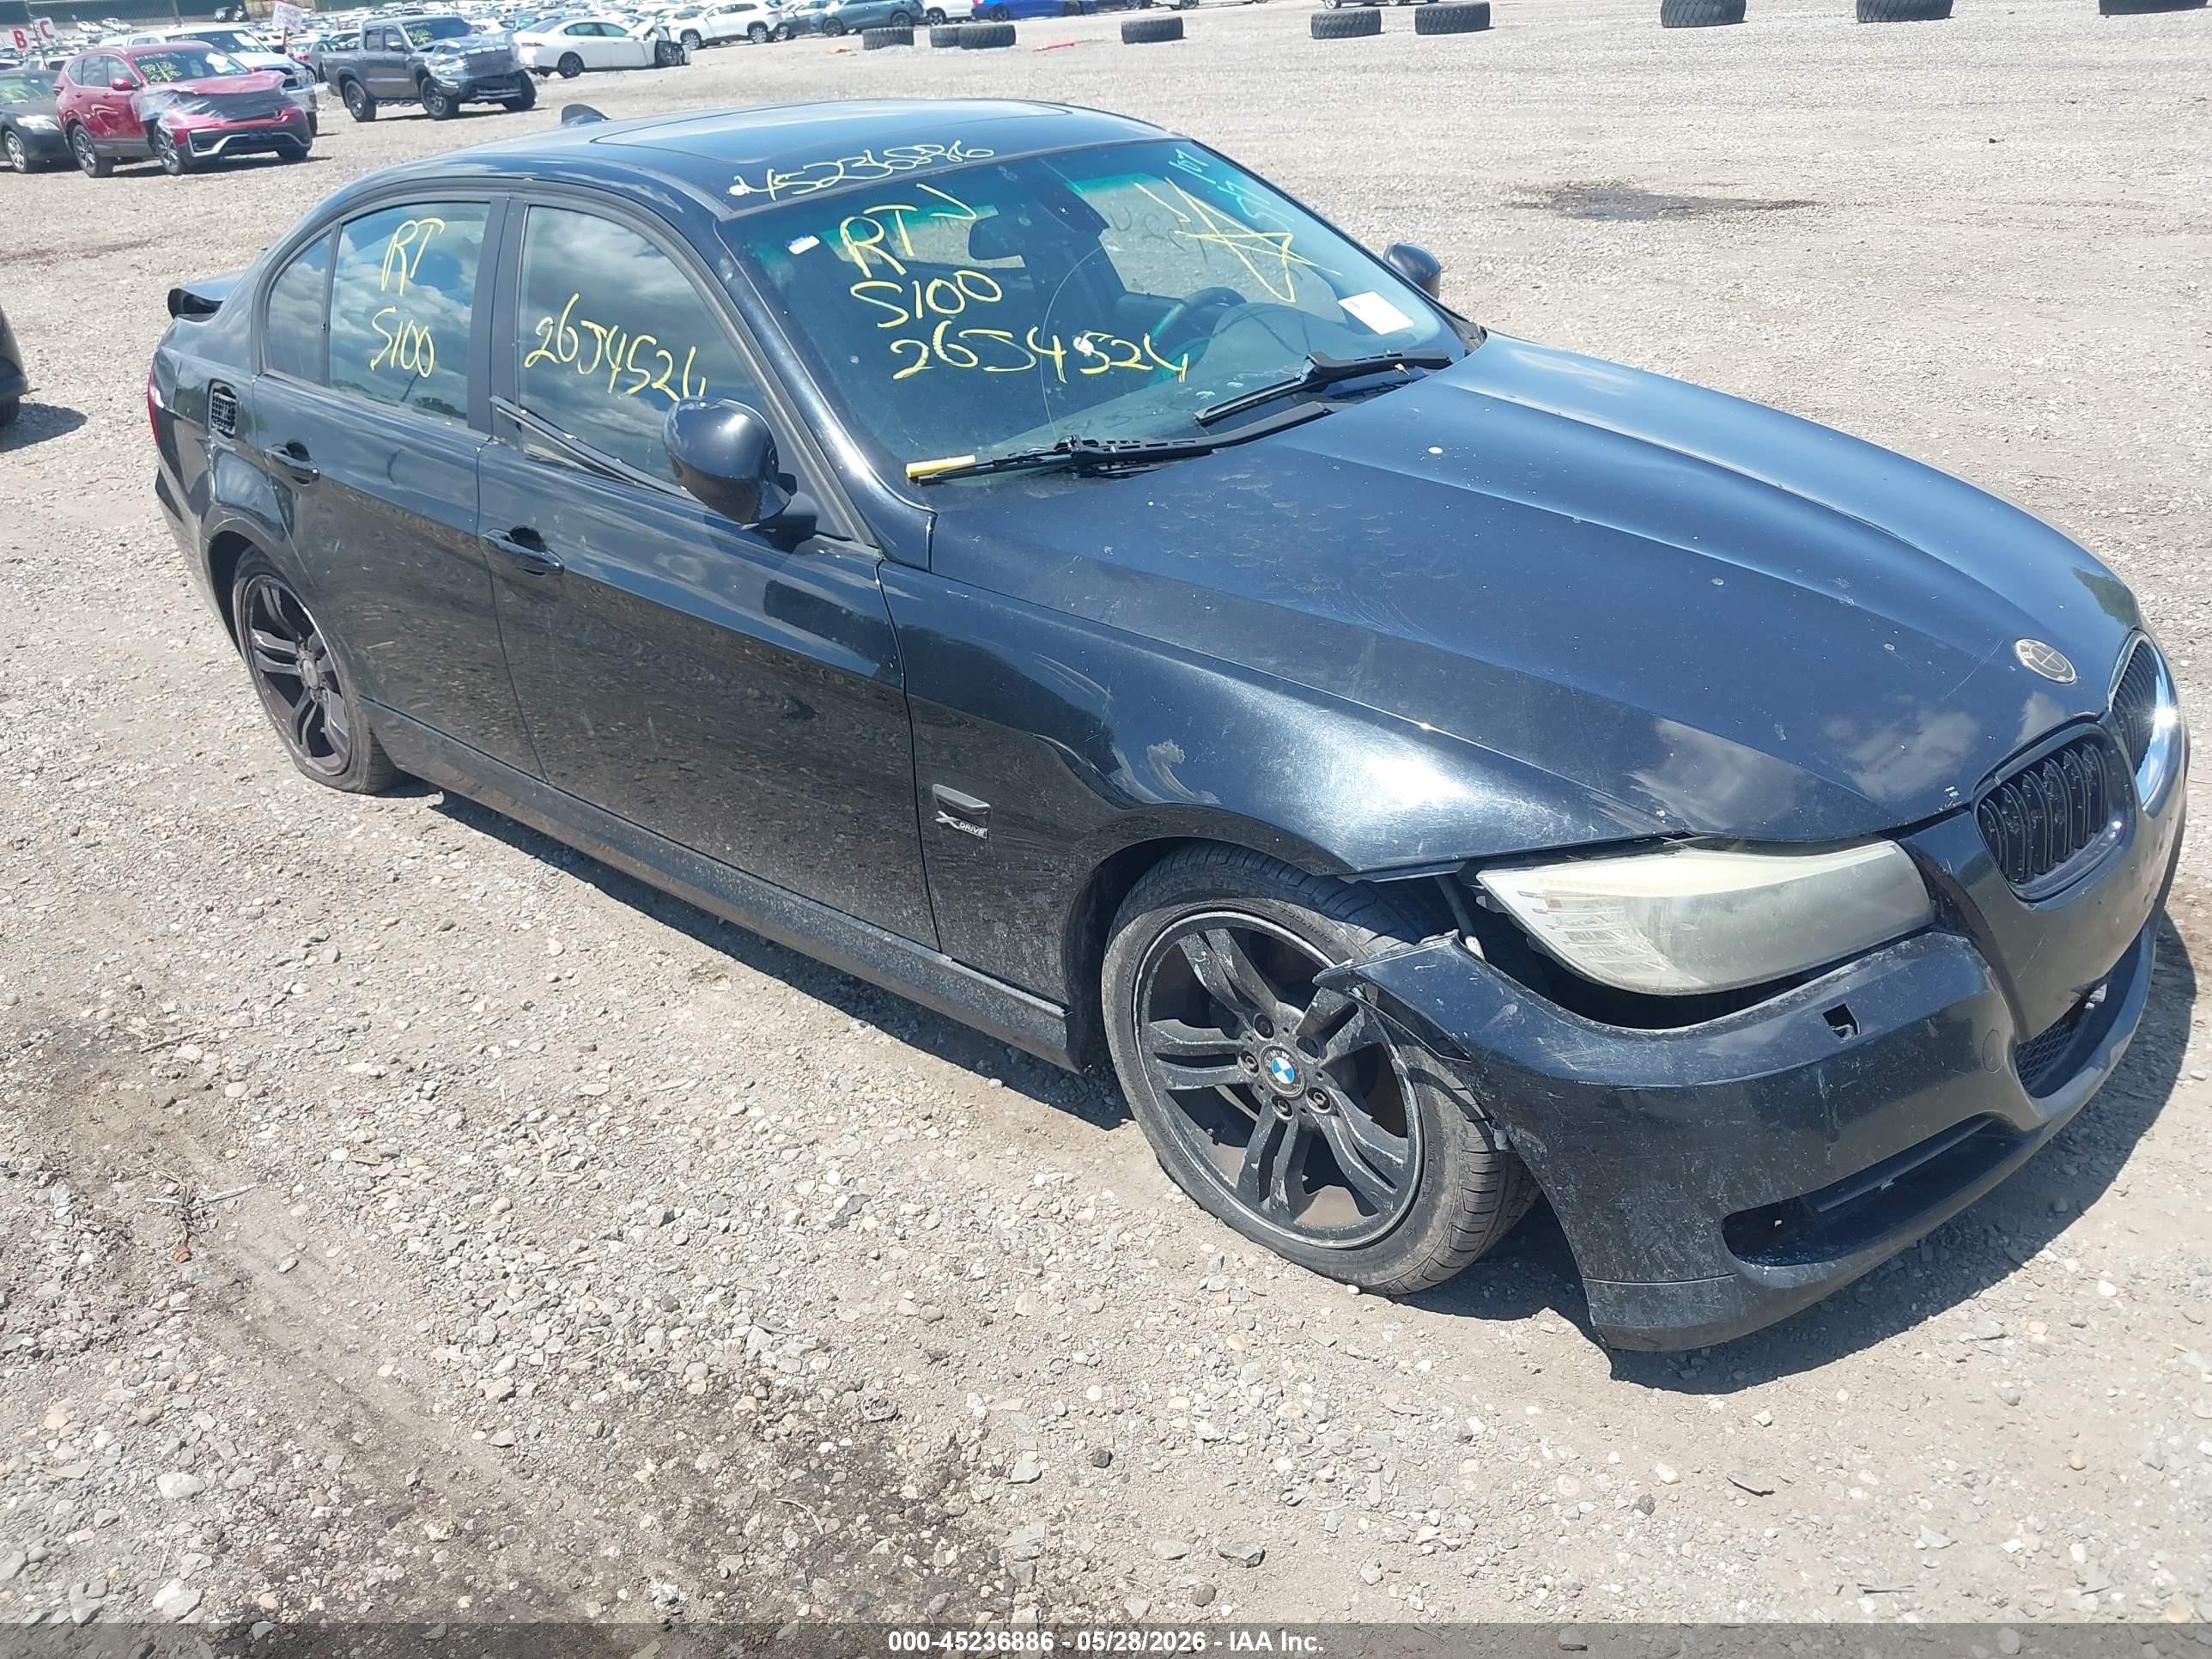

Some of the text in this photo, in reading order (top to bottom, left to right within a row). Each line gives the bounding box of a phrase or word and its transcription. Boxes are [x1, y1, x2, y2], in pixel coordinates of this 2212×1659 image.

[13, 30, 27, 49] B
[40, 21, 55, 39] C
[380, 217, 446, 295] RT
[839, 204, 918, 278] RT
